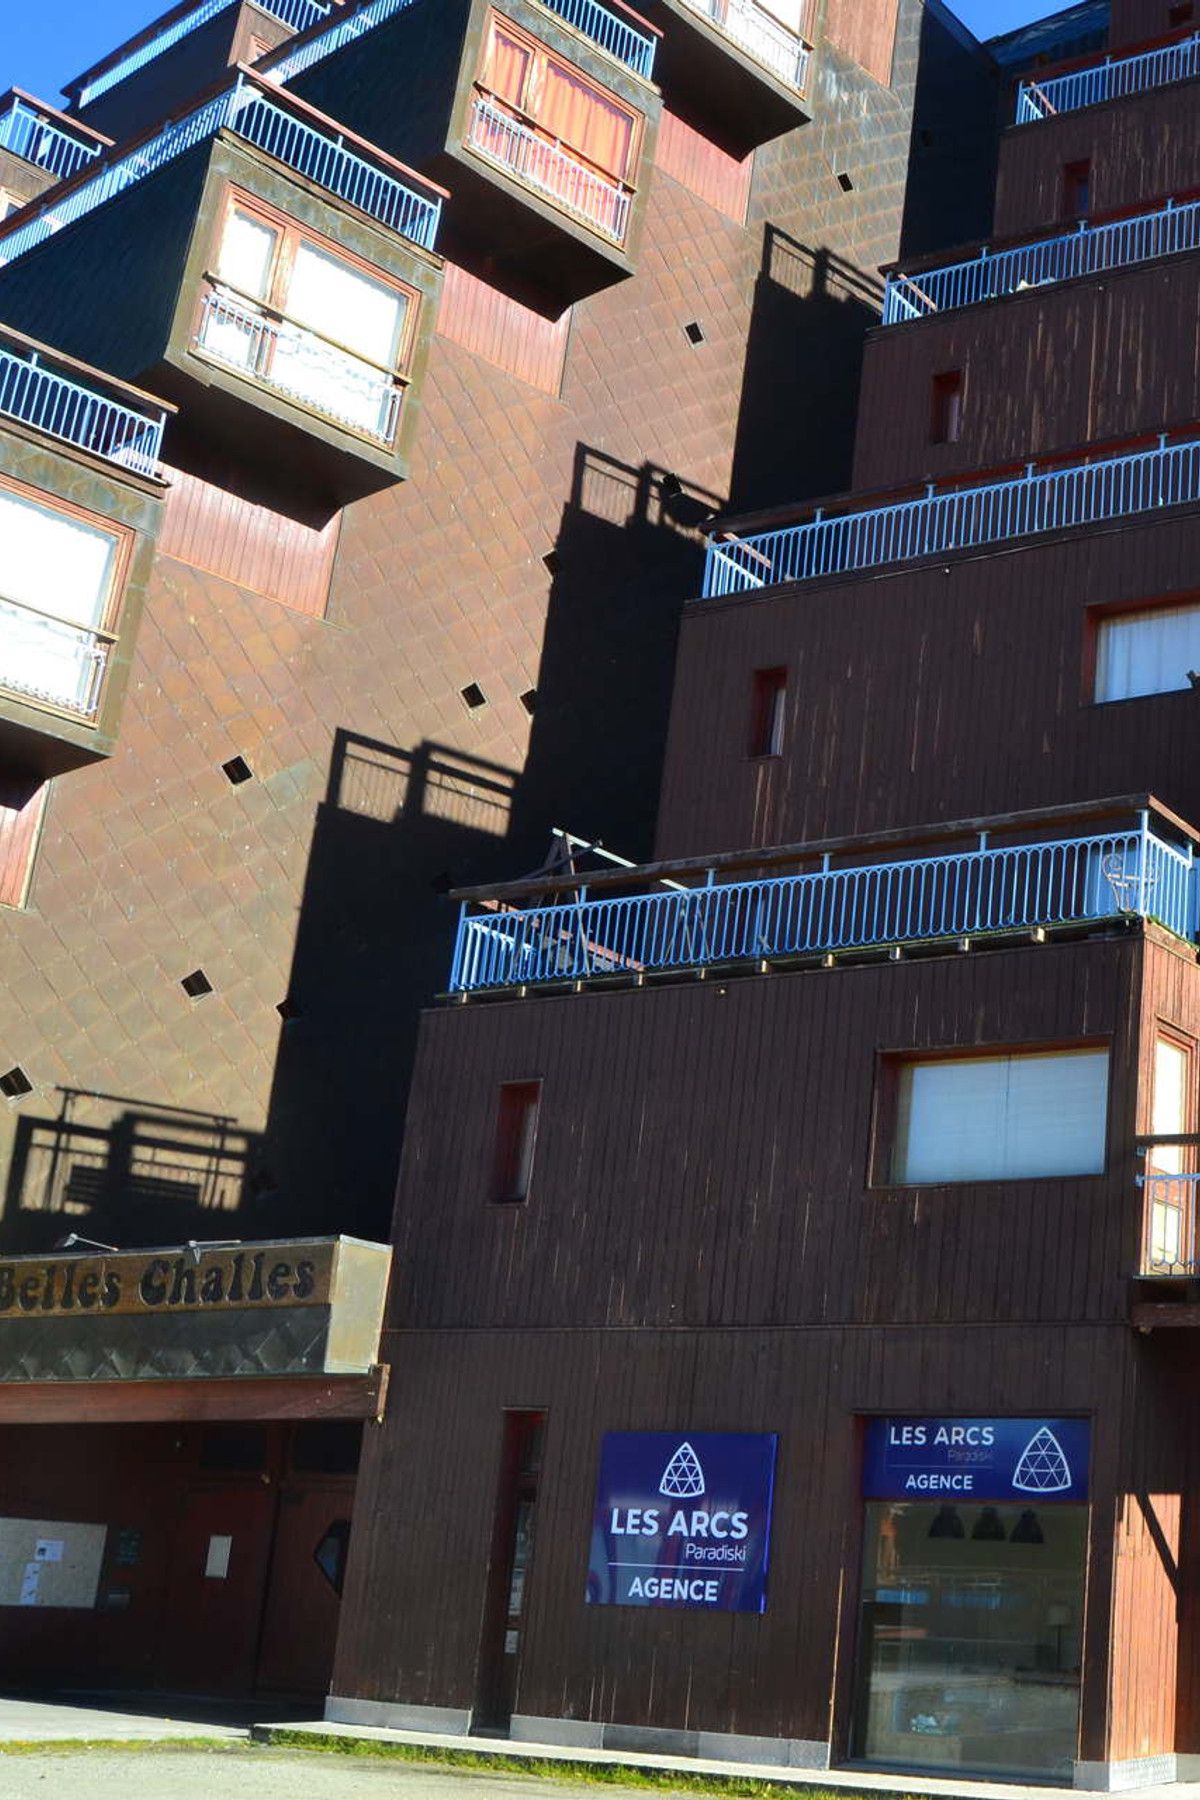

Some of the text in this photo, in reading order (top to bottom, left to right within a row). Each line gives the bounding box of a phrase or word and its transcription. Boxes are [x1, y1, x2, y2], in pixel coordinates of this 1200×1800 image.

[138, 1252, 317, 1307] Challes
[890, 1426, 994, 1446] LES ARCS
[905, 1474, 974, 1490] AGENCE
[610, 1508, 749, 1539] LES ARCS
[685, 1543, 747, 1562] Paradiski
[628, 1576, 719, 1602] AGENCE
